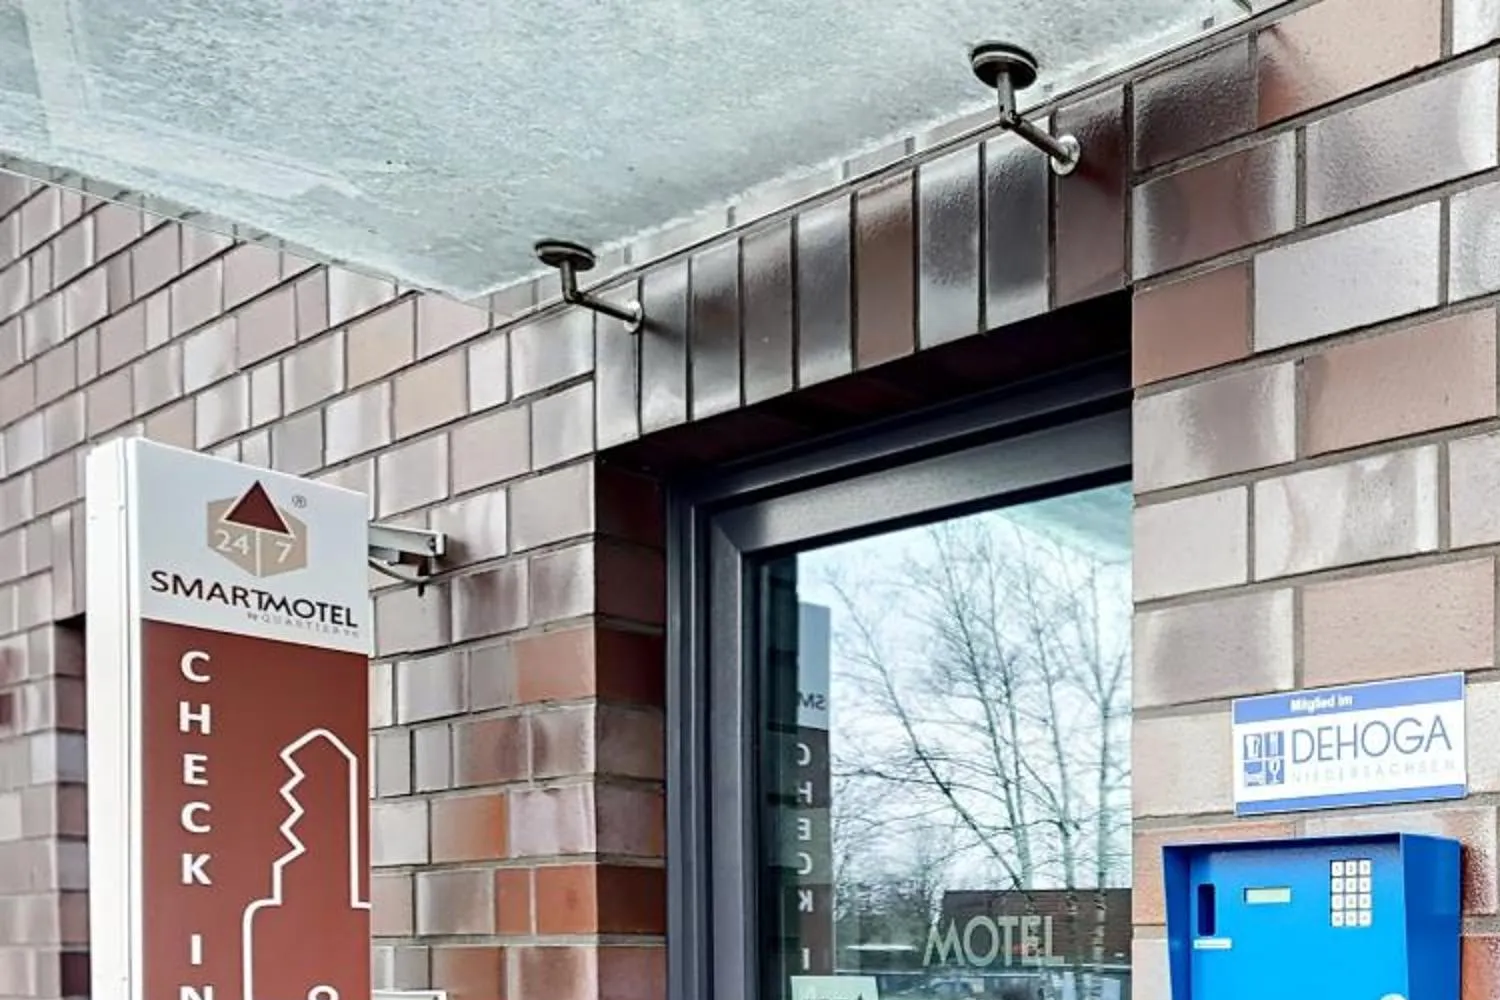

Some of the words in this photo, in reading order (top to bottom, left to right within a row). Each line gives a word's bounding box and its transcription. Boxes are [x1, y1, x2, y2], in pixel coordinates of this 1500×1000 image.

[214, 529, 251, 556] 24
[275, 540, 296, 564] 7
[150, 569, 359, 629] SMARTMOTEL
[1292, 715, 1453, 764] DEHOGA
[178, 650, 212, 886] CHECK
[922, 915, 1065, 968] MOTEL
